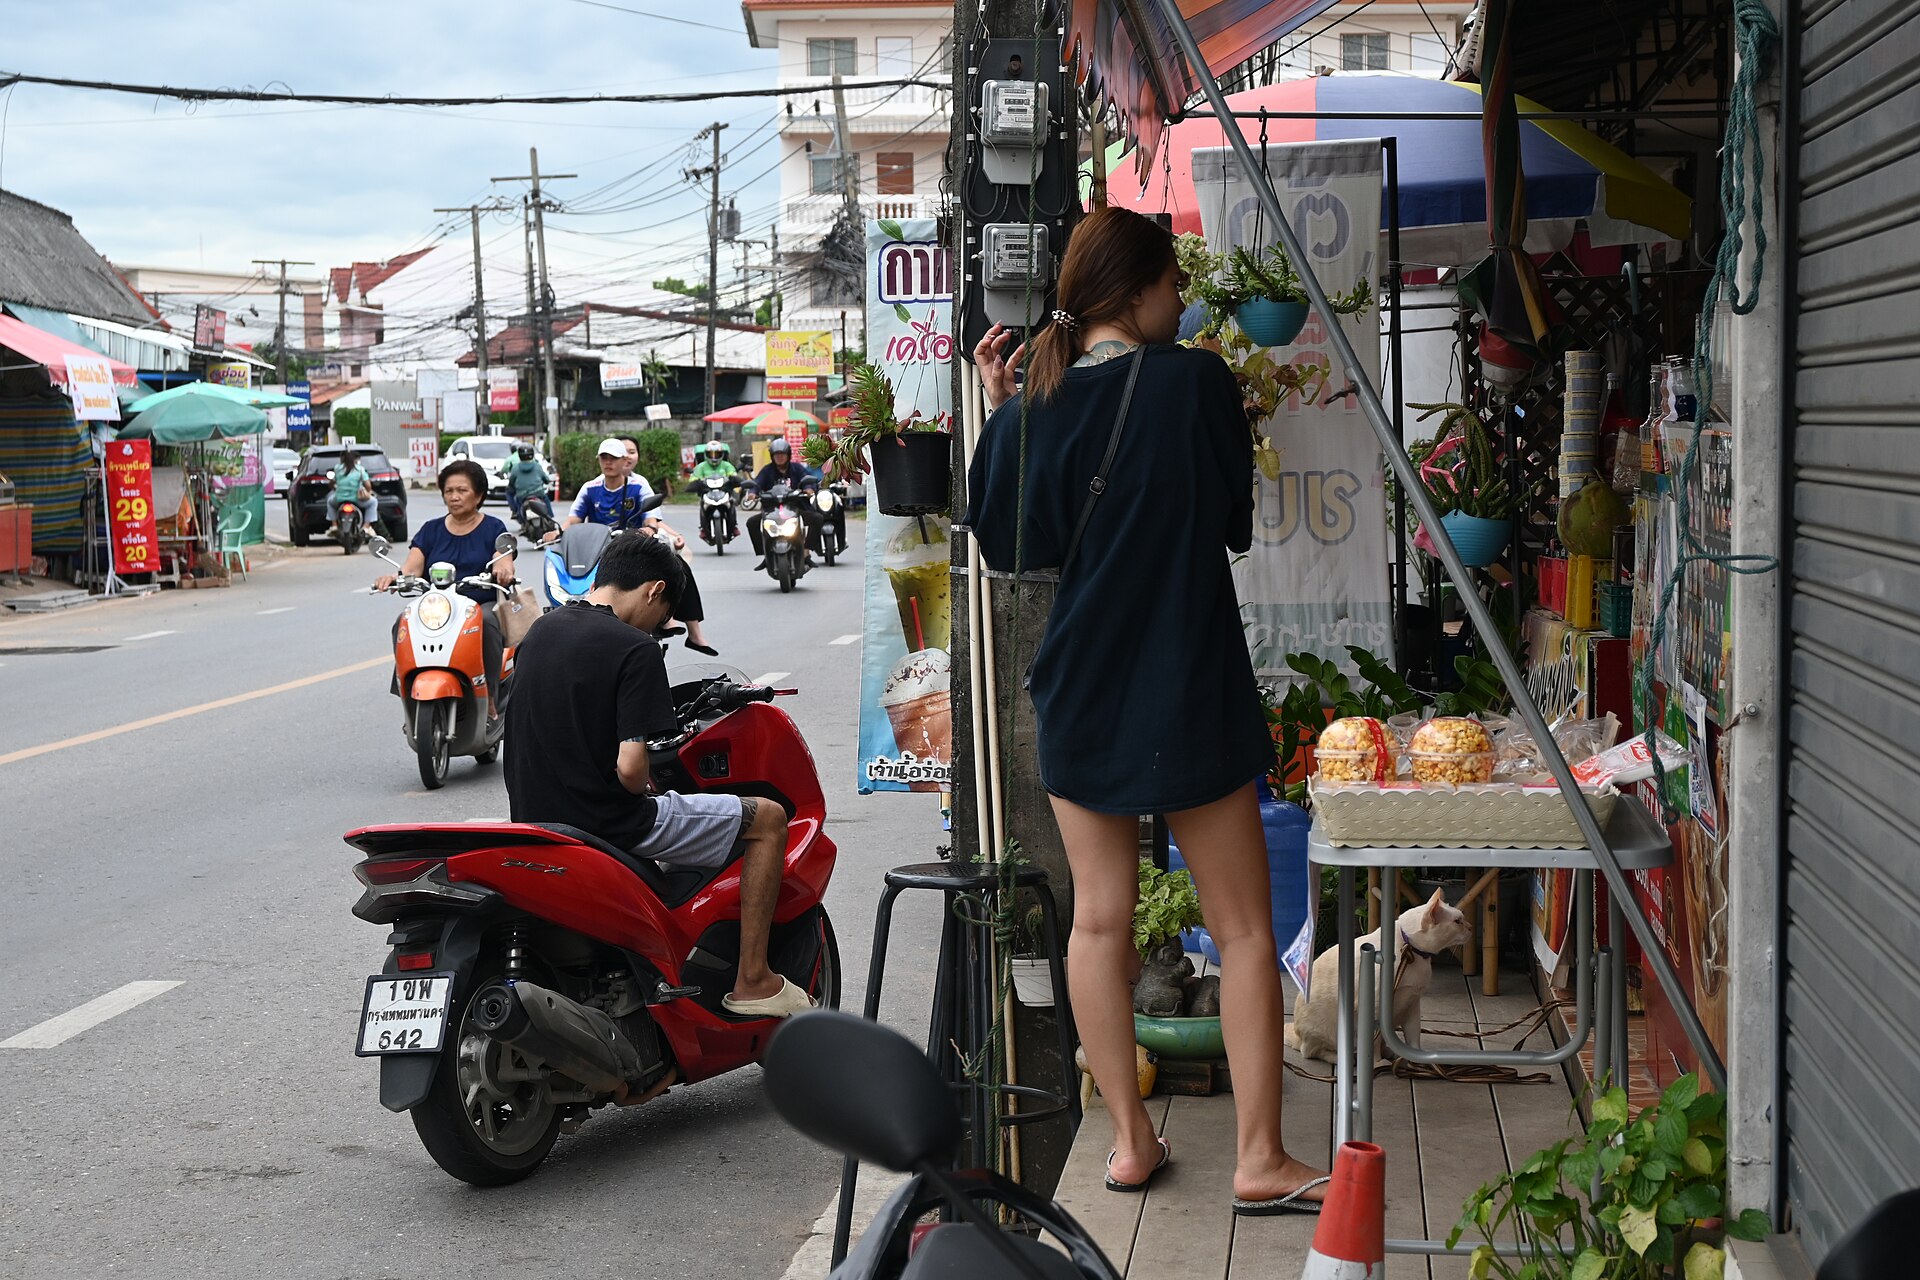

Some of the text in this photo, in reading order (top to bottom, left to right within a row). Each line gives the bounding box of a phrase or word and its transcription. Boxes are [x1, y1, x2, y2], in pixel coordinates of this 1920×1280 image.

[886, 248, 953, 296] กาแ
[116, 497, 148, 521] 29
[125, 545, 147, 562] 20
[500, 857, 568, 876] PCX
[367, 1007, 444, 1025] กรุงเทพมหานคร
[378, 1028, 423, 1050] 642
